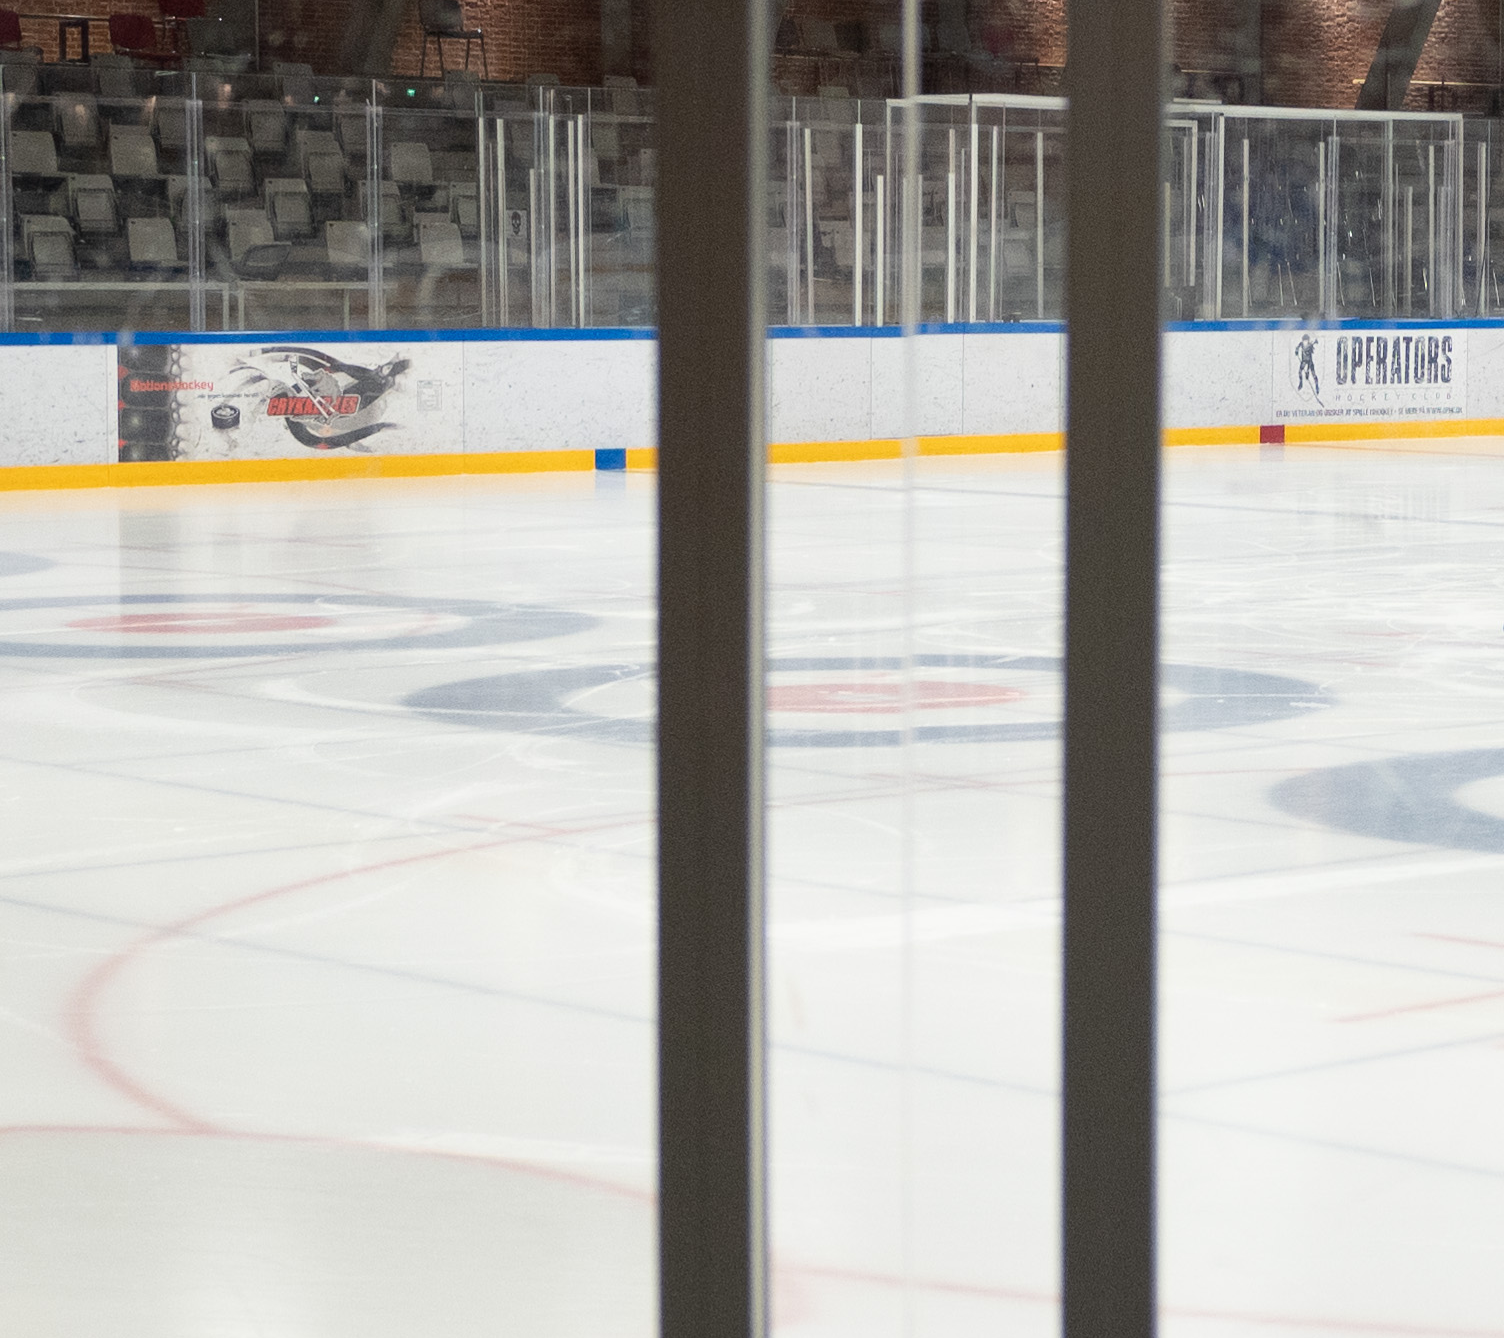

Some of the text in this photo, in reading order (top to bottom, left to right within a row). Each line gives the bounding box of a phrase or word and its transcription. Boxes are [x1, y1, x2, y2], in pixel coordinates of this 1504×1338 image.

[1336, 335, 1453, 385] OPERATORS
[1335, 391, 1452, 402] HOCKEY CLUB
